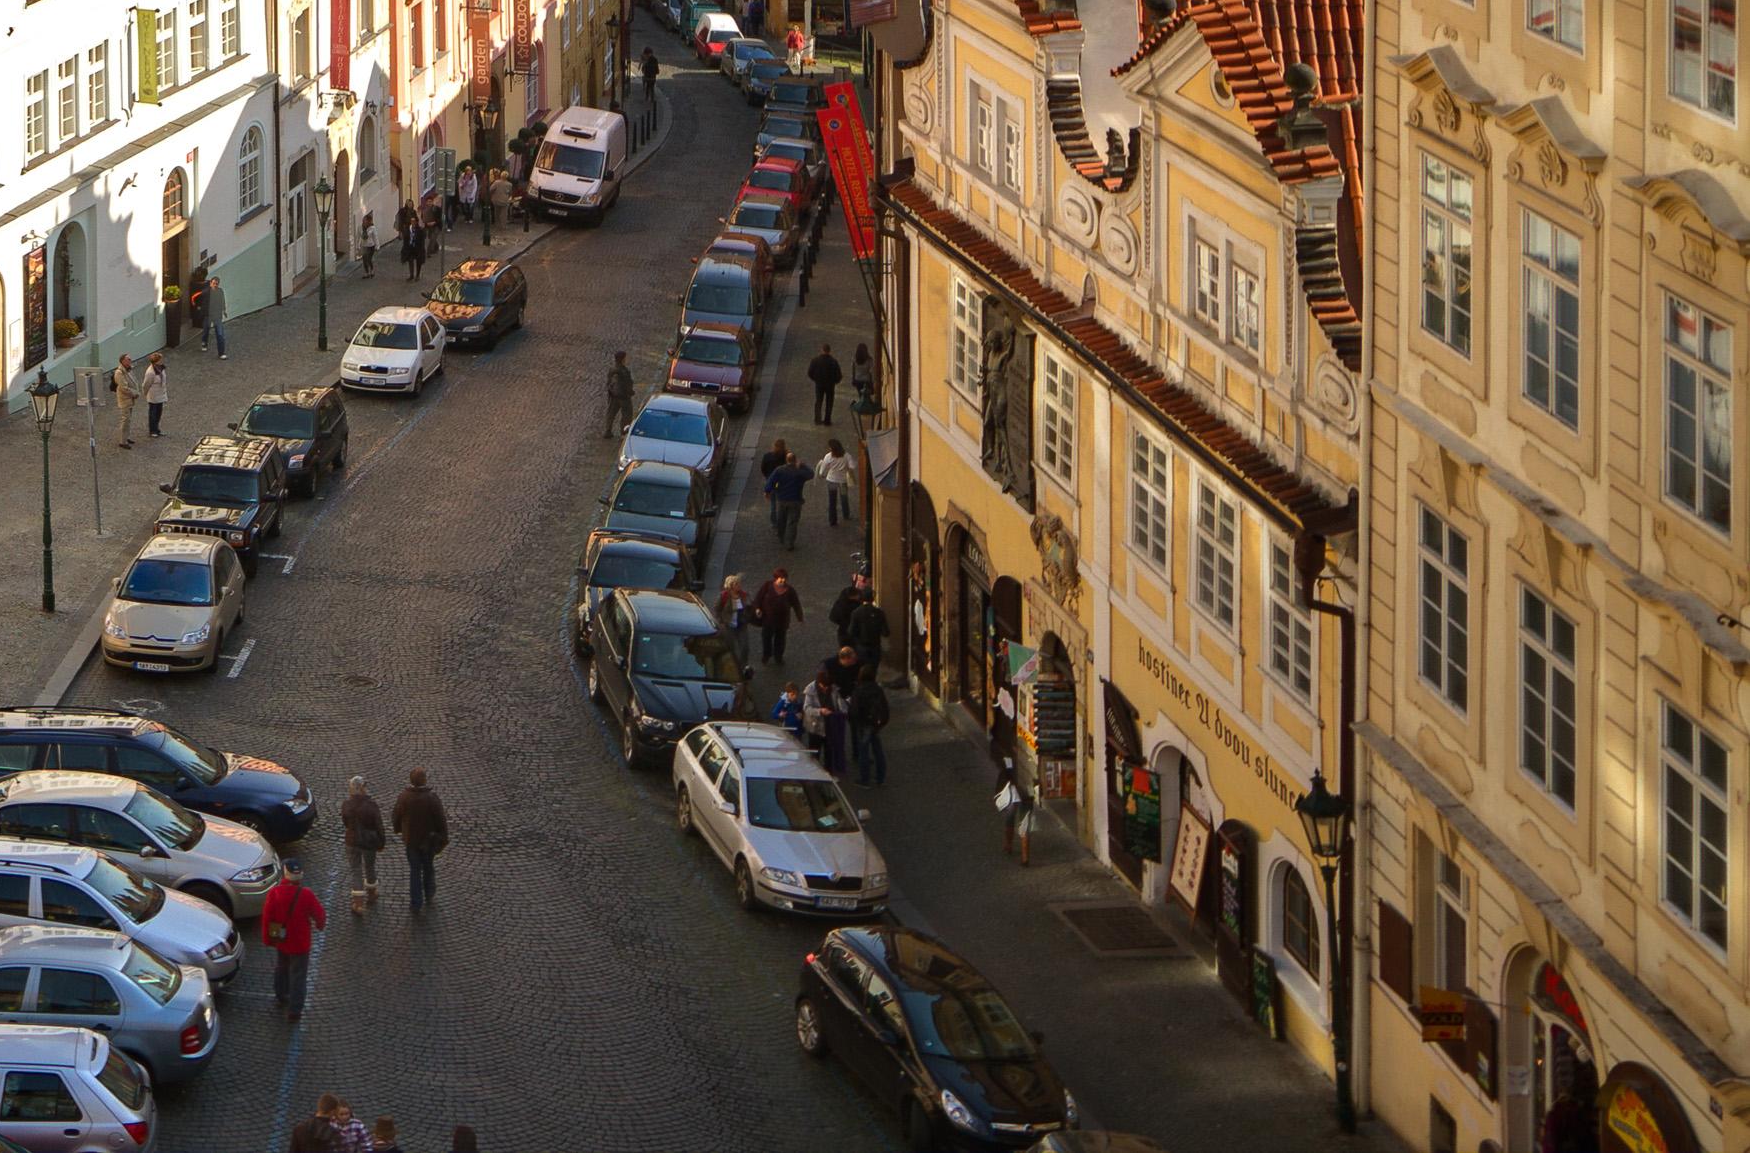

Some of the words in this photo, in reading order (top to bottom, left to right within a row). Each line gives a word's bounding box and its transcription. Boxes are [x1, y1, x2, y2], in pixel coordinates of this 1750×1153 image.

[1138, 637, 1191, 710] hostinec
[1215, 708, 1251, 768] dvou
[1255, 754, 1302, 811] slunc
